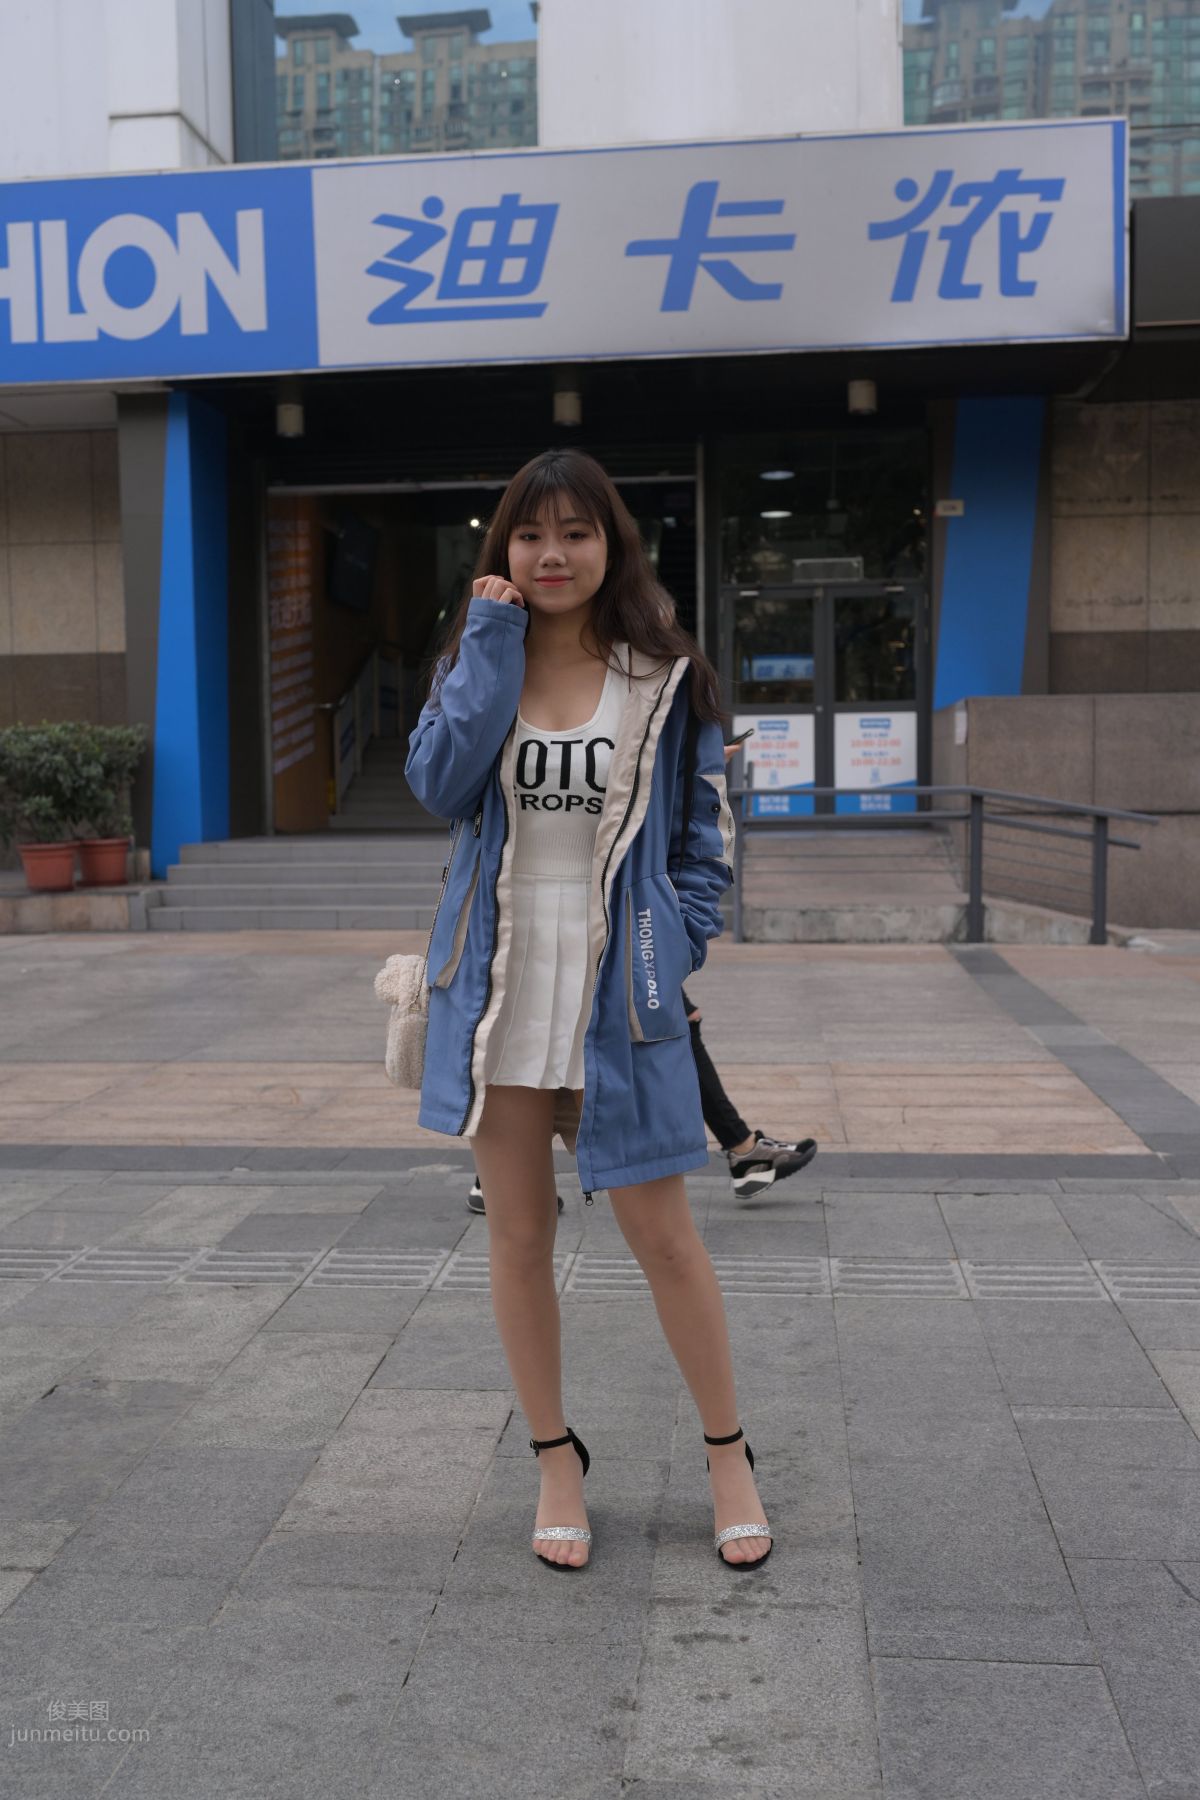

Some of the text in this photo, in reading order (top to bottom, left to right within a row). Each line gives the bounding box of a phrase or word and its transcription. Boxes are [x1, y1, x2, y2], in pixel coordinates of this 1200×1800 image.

[365, 169, 1066, 325] 迪卡侬
[513, 737, 615, 793] OTC
[514, 794, 603, 815] ROPS
